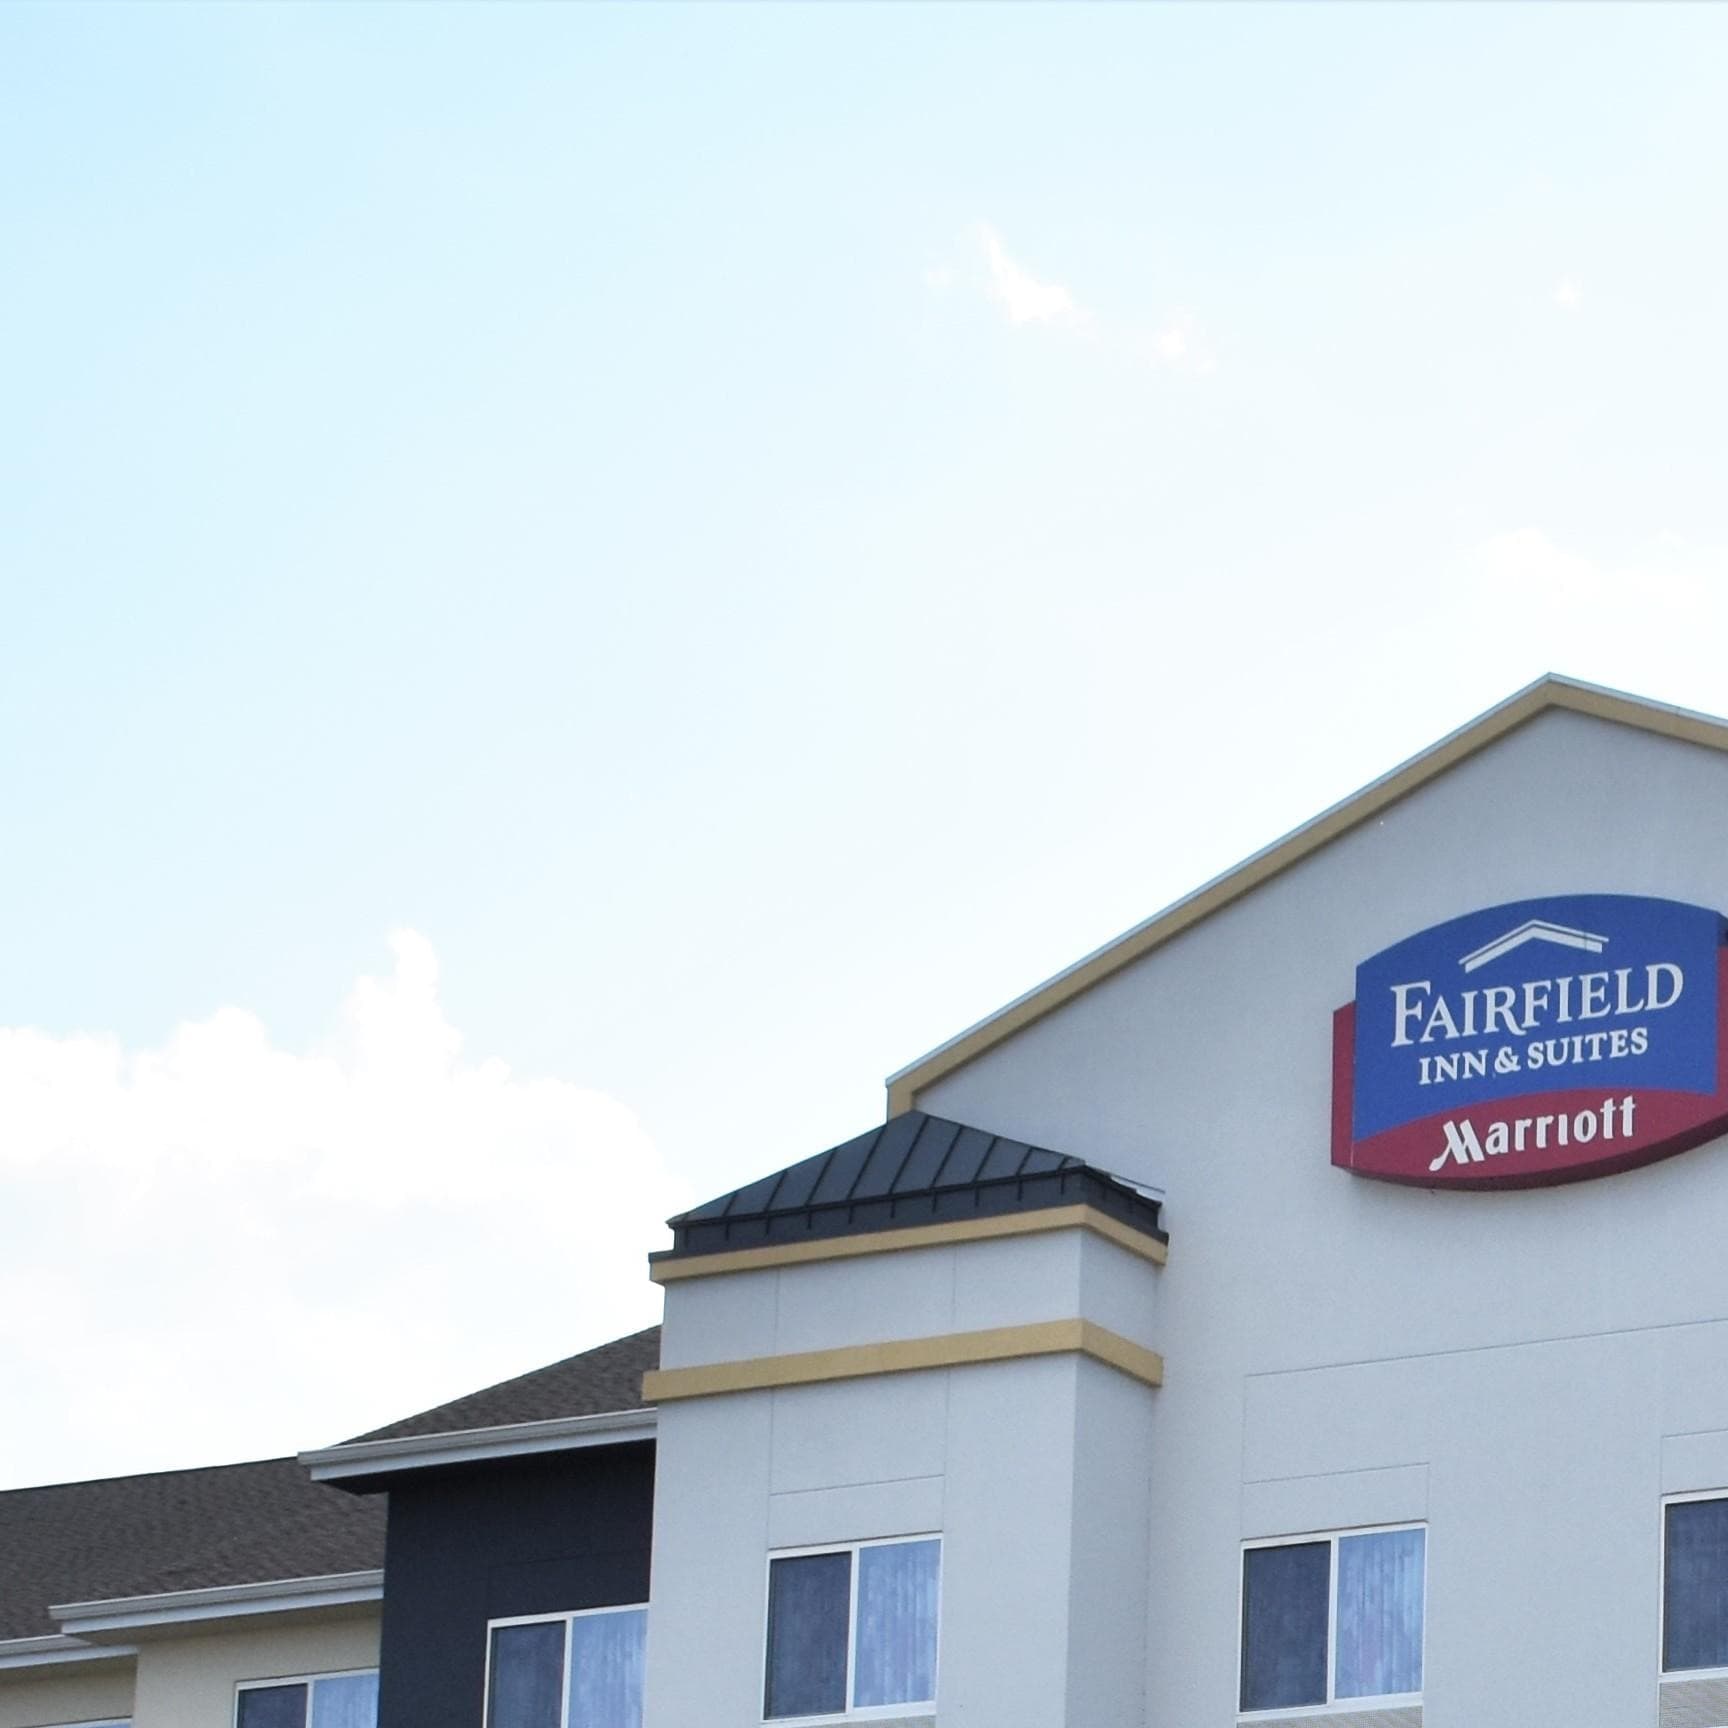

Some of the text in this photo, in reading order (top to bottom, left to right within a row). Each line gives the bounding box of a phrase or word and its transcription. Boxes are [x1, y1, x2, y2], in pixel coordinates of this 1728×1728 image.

[1390, 961, 1685, 1048] FAIRFIELD
[1418, 1026, 1649, 1086] INN & SUITES
[1428, 1094, 1637, 1172] Marriott
